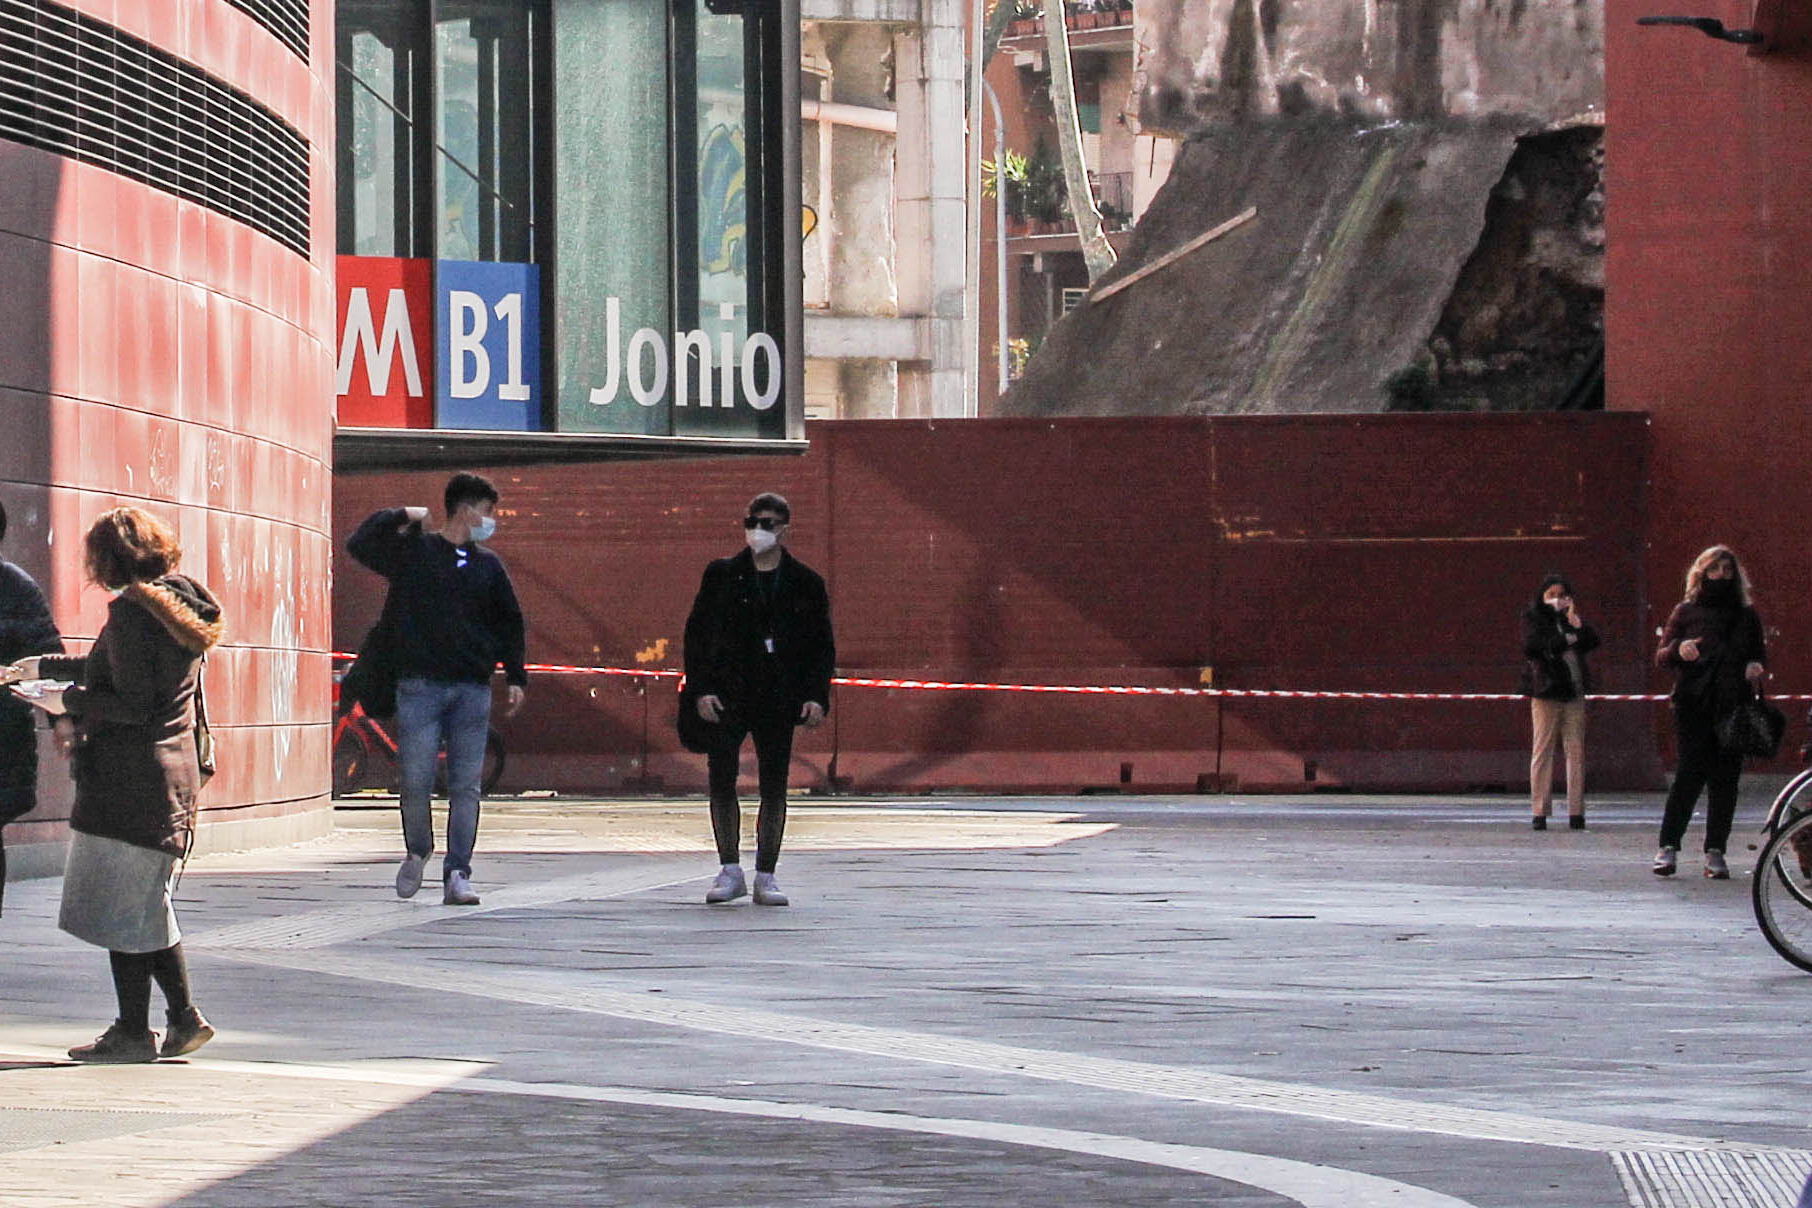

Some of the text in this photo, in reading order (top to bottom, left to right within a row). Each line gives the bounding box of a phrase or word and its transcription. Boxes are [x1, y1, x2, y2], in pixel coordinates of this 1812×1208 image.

[336, 288, 783, 410] M B1 Jonio
